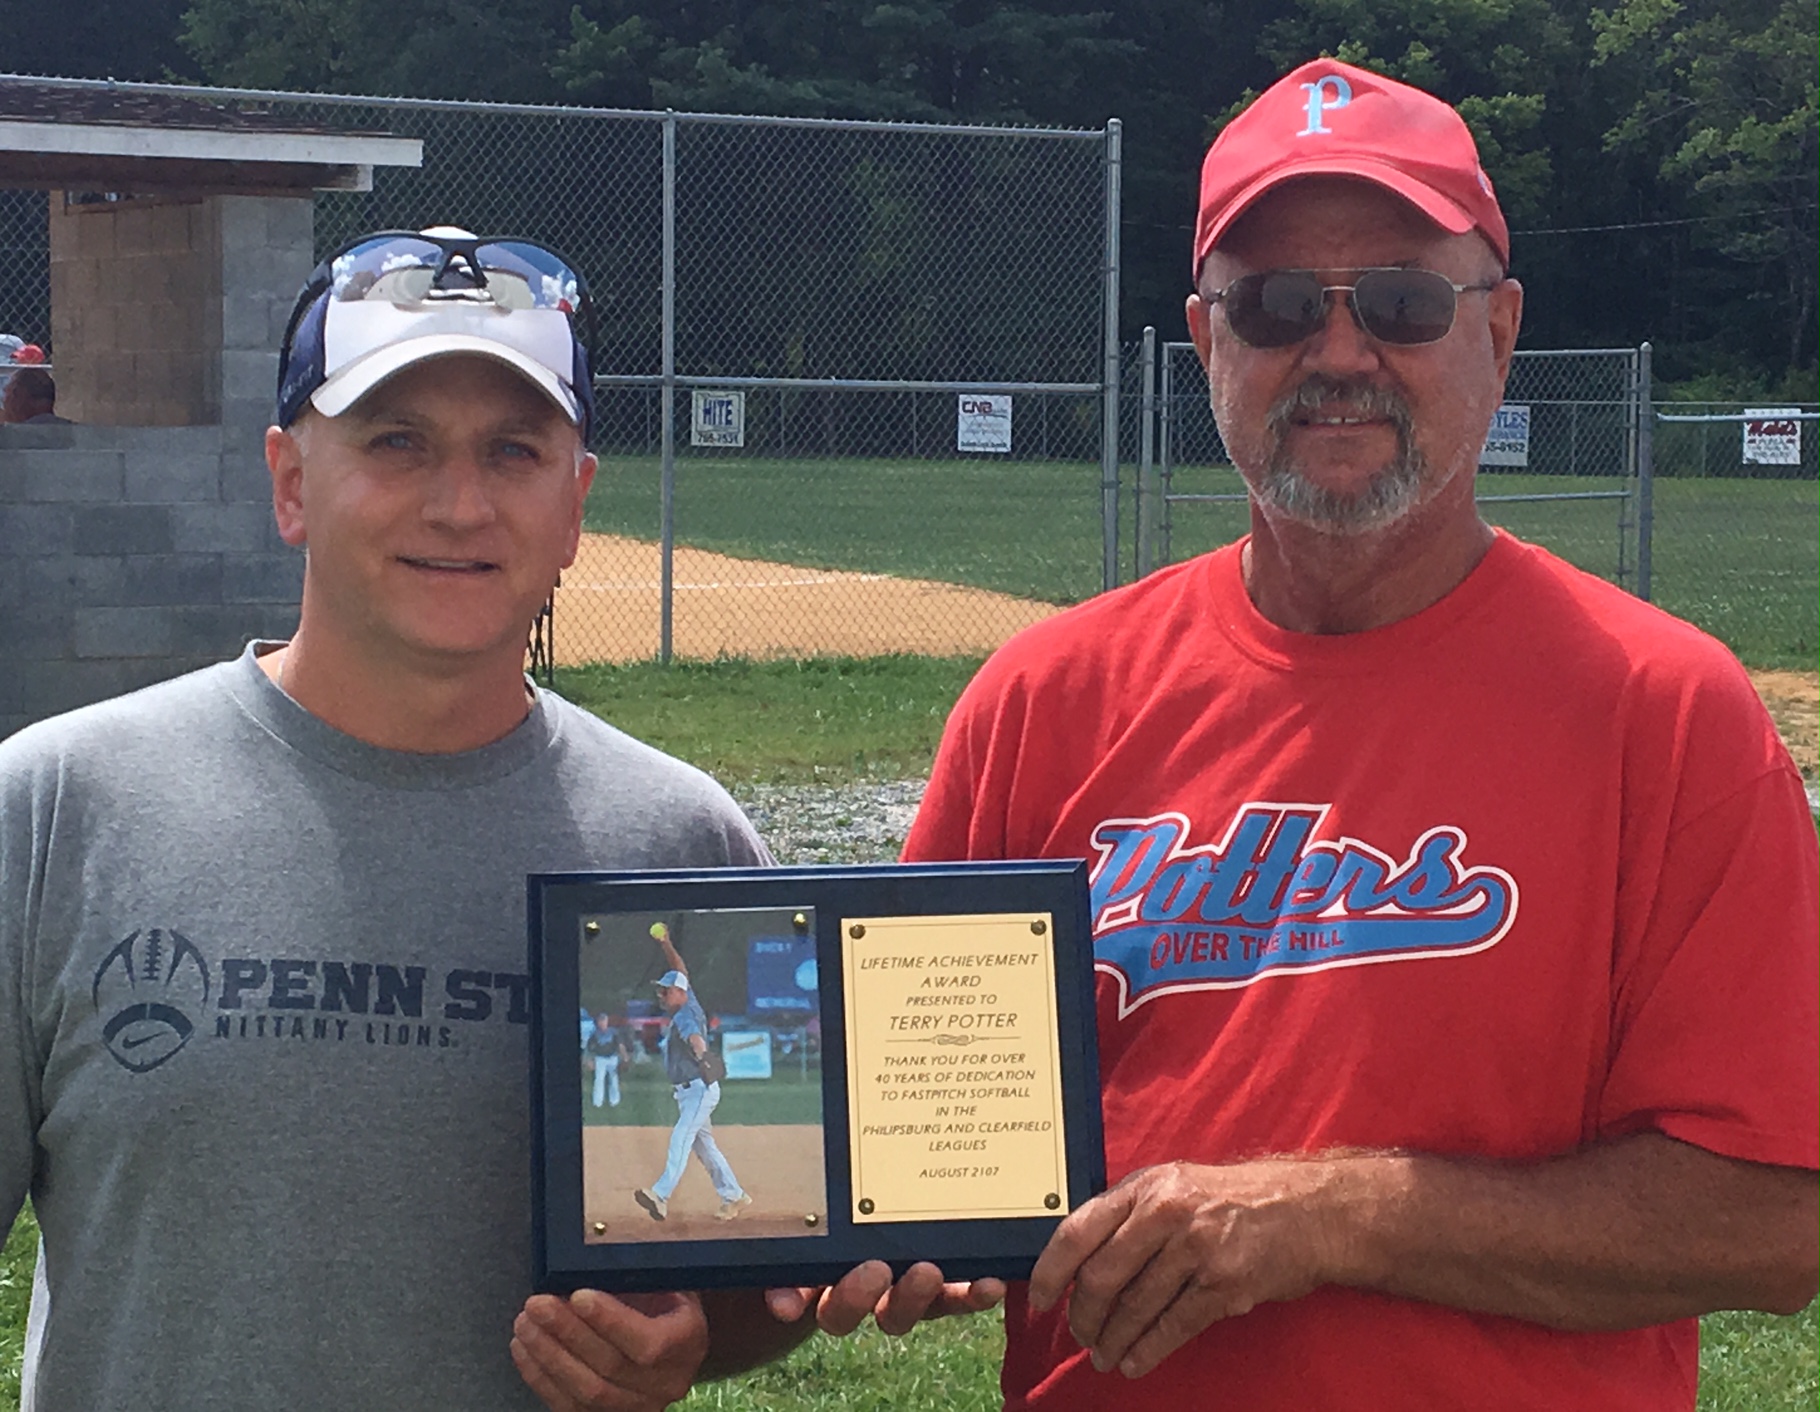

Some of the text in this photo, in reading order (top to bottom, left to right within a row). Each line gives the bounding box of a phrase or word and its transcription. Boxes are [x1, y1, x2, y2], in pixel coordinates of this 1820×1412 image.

[1297, 75, 1352, 136] P
[703, 400, 733, 425] HITE
[962, 401, 993, 414] CNB
[1150, 929, 1345, 970] OVER THE HILL
[860, 953, 1039, 969] LIFETIME ACHIEVEMENT
[218, 959, 426, 1017] PENN
[920, 975, 981, 988] AWARD
[906, 994, 997, 1007] PRESENTED TO
[215, 1015, 348, 1041] NITTANY
[890, 1013, 1018, 1030] TERRY POTTER
[884, 1053, 1026, 1067] THANK YOU FOR OVER
[875, 1070, 1036, 1084] 40 YEARS OF DEDICATION
[881, 1087, 1031, 1101] TO FASTPITCH SOFTBALL
[935, 1105, 977, 1117] IN THE
[862, 1121, 1052, 1136] PHILIPSBURG AND CLEARFIELD
[928, 1140, 987, 1152] LEAGUES
[919, 1167, 999, 1179] AUGUST 2107
